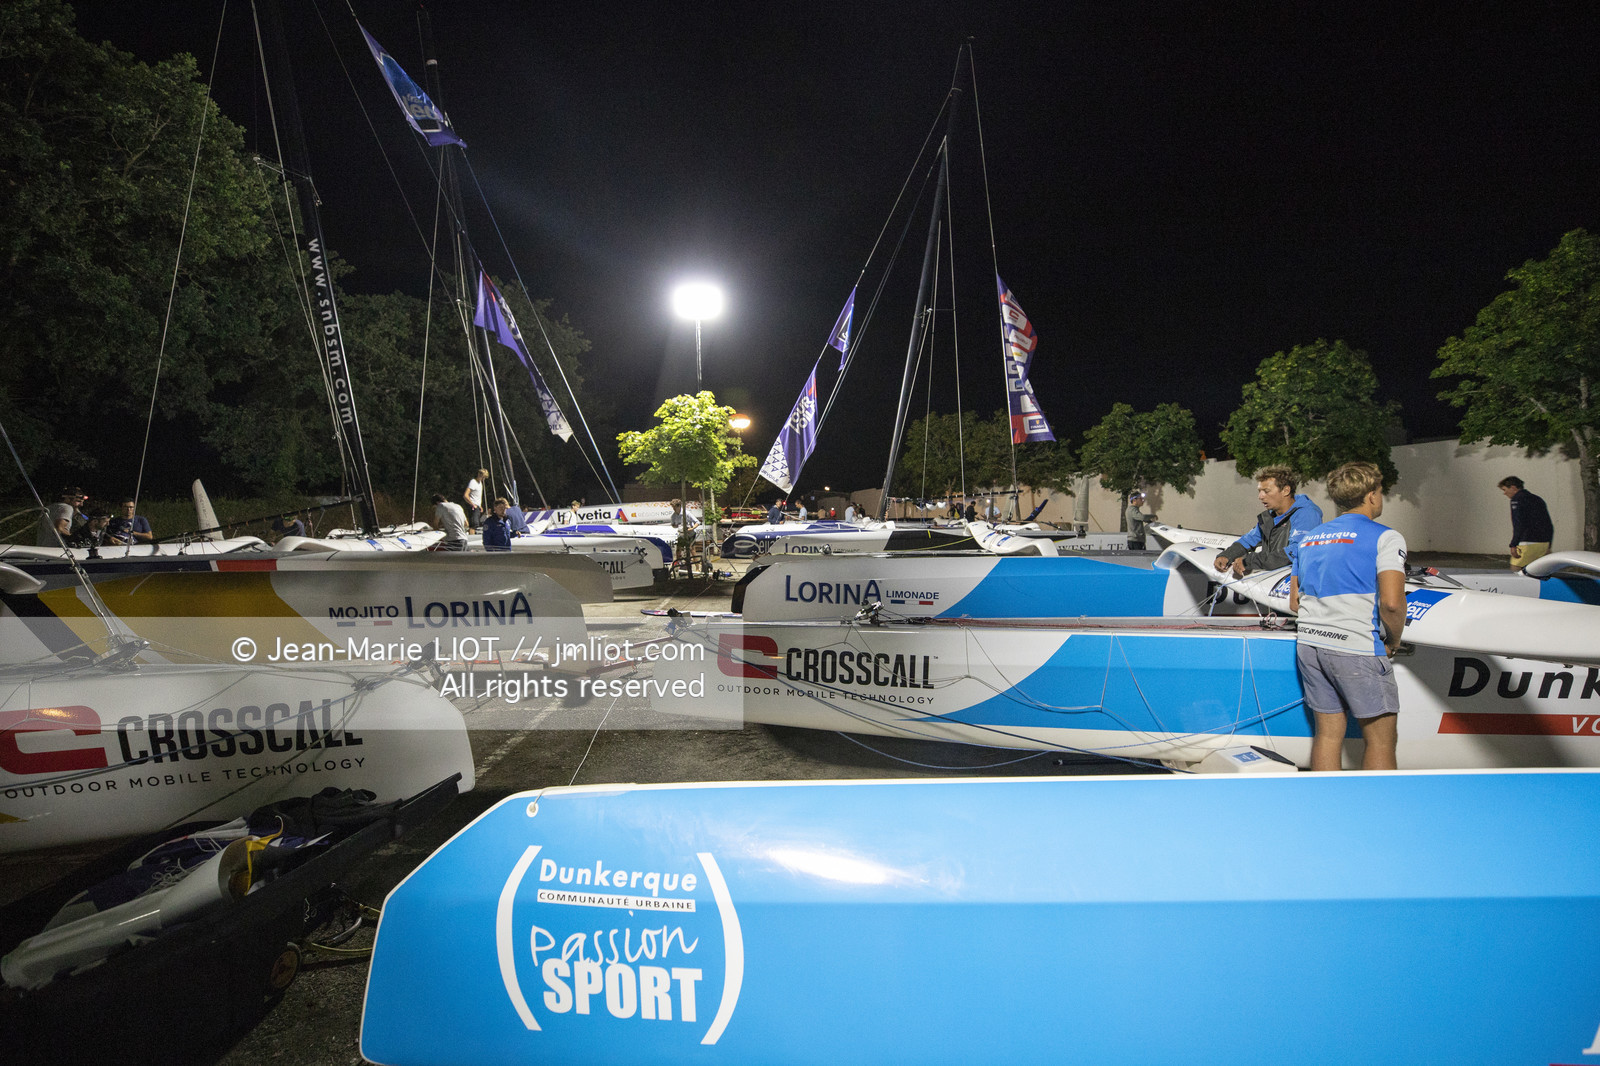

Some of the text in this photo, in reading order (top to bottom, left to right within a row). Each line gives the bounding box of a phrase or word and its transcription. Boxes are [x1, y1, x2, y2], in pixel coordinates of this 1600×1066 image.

[308, 238, 353, 424] www.snbsm.com
[784, 396, 810, 430] TOUR
[557, 509, 611, 524] hvetia
[1302, 531, 1358, 543] Dunkerque
[785, 574, 940, 605] LORINA LIMONADE
[328, 592, 534, 630] MOJITO LORINA
[786, 647, 935, 690] CROSSCALL
[717, 684, 934, 706] OUTDOOR MOBILE TECHNOLOGY
[117, 698, 363, 766] CROSSCALL
[4, 757, 366, 799] OUTDOOR MOBILE TECHNOLOGY
[539, 859, 697, 897] Dunkerque
[539, 891, 693, 910] COMMUNAUTÉ URBAINE
[542, 958, 703, 1022] SPORT
